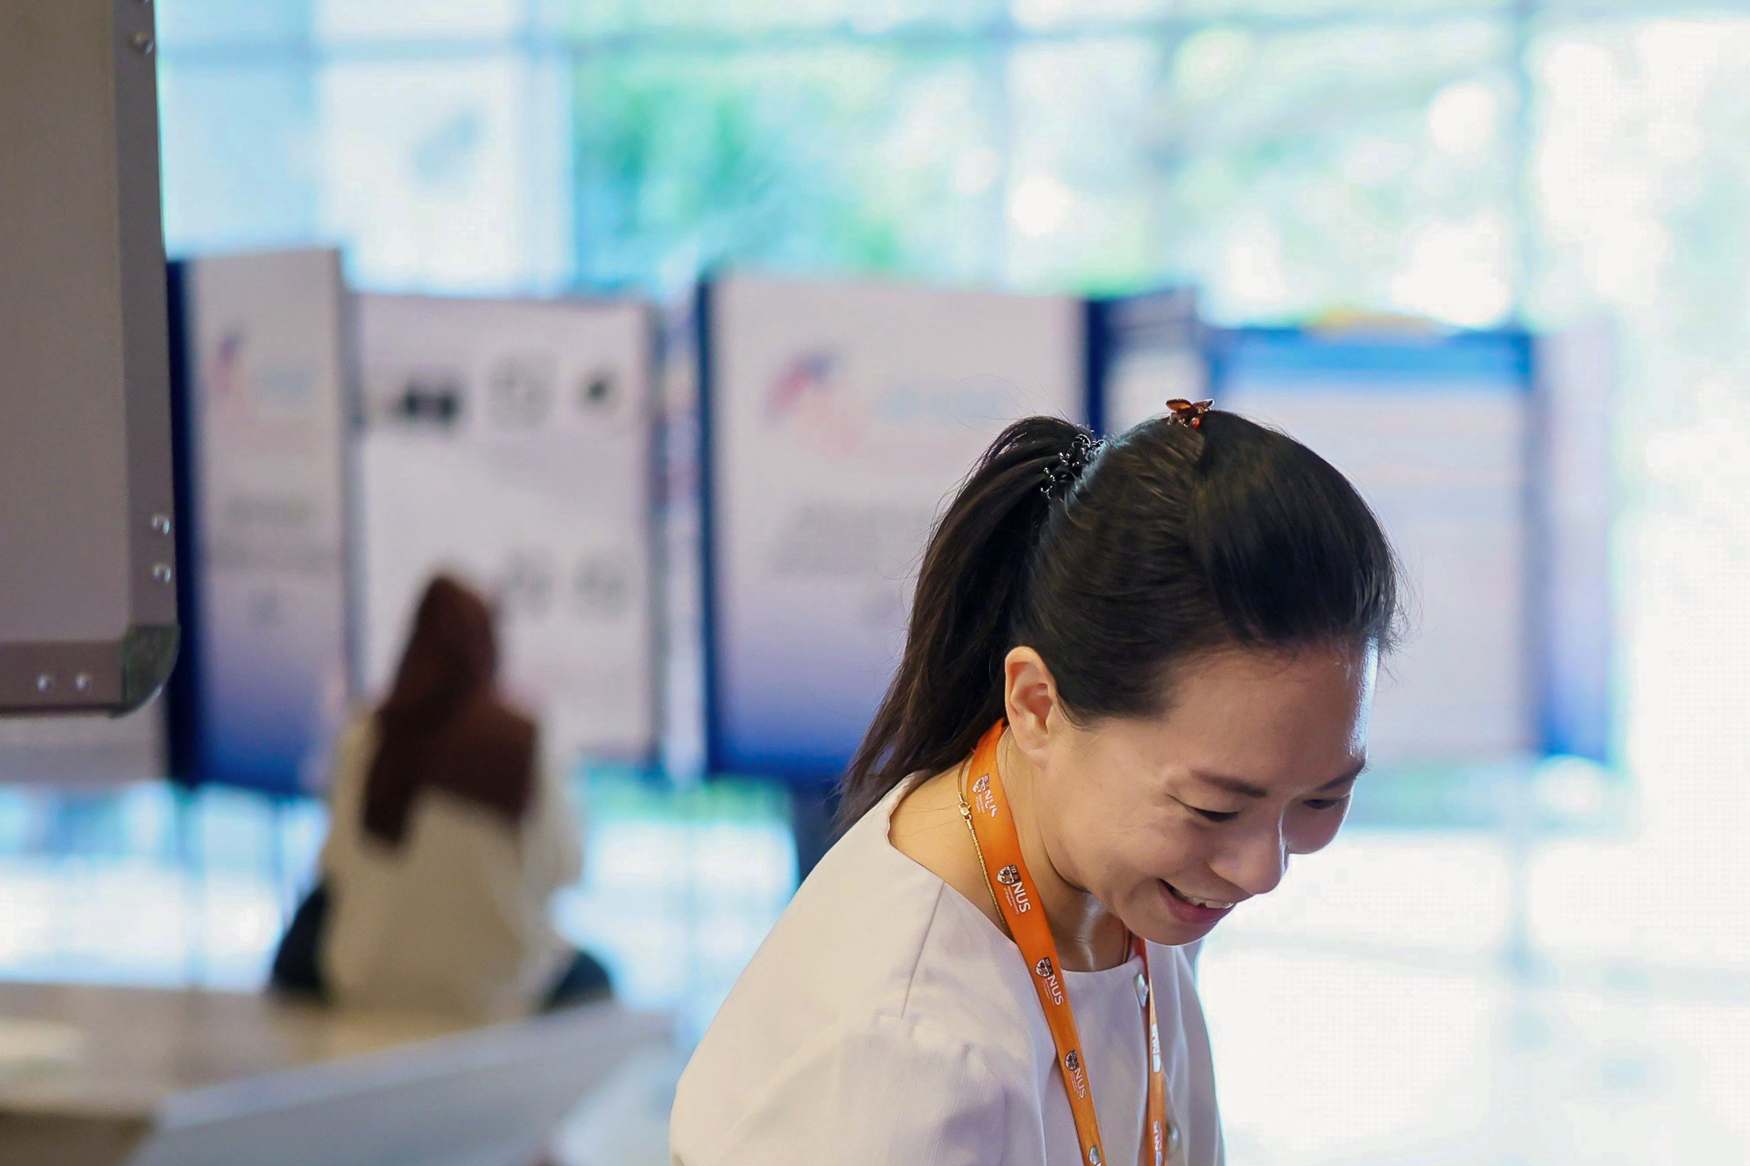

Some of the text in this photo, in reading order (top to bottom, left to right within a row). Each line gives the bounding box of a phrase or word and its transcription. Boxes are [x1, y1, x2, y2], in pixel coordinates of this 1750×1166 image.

[1011, 881, 1031, 913] NUS
[1047, 974, 1064, 1006] NUS
[1074, 1067, 1086, 1099] NUS
